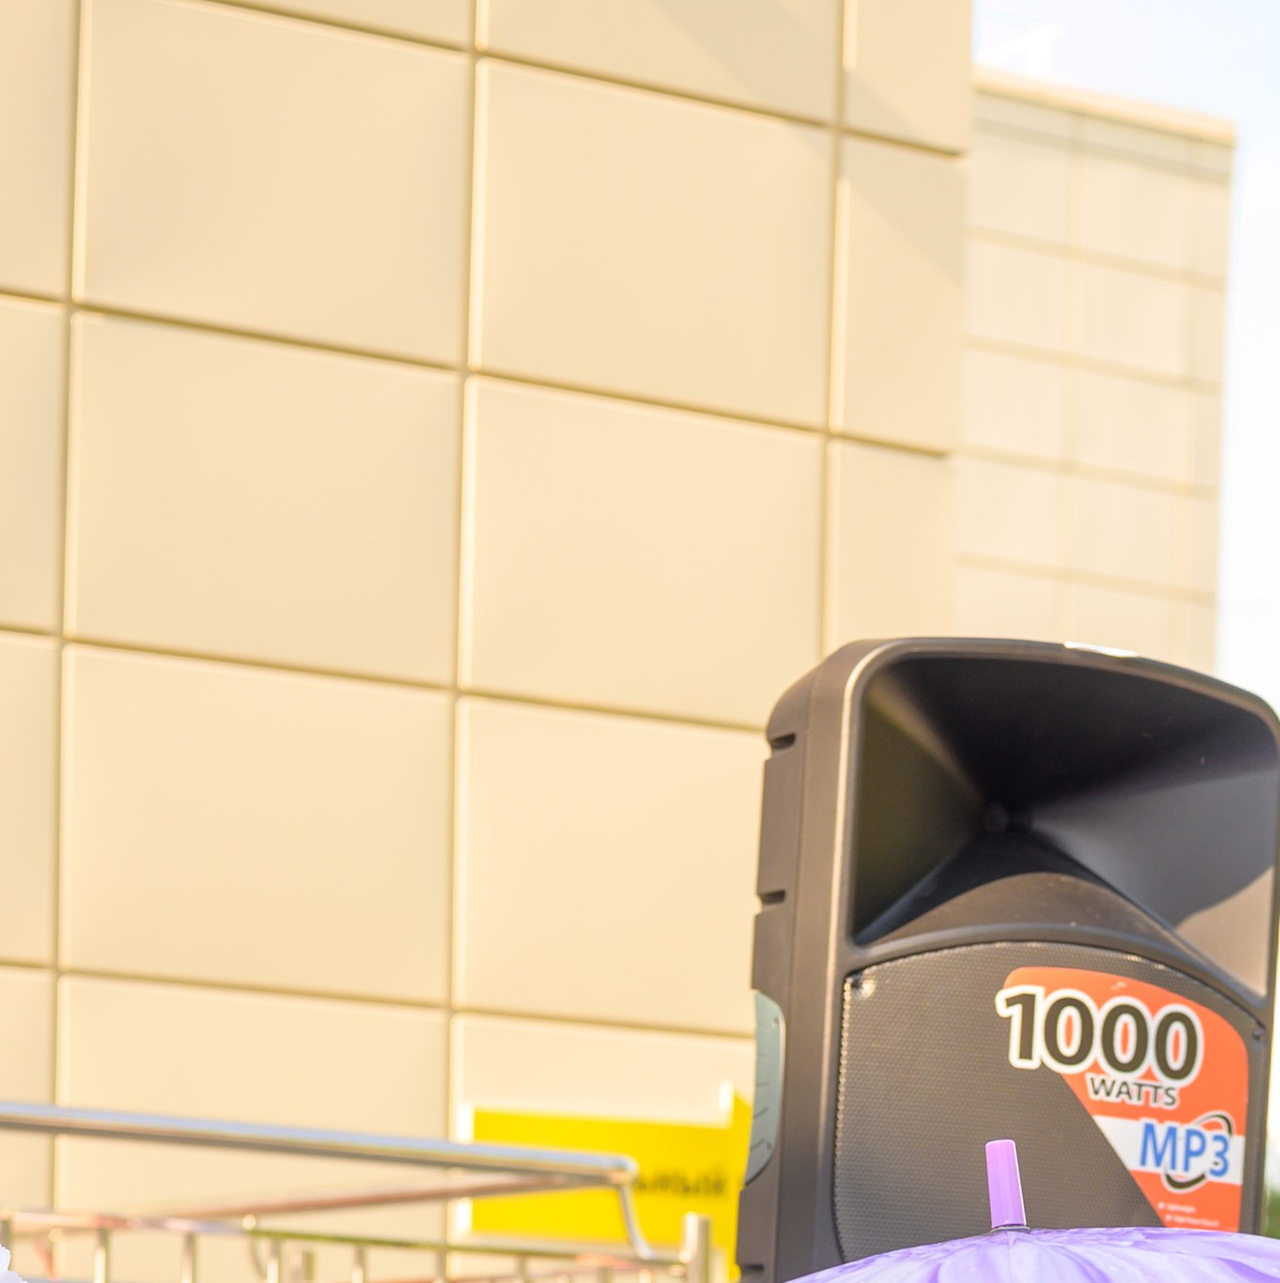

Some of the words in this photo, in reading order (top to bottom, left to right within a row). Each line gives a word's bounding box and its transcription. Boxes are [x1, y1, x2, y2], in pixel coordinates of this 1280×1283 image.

[1002, 990, 1199, 1083] 1000
[1089, 1076, 1177, 1107] WATTS
[1139, 1122, 1230, 1178] MP3
